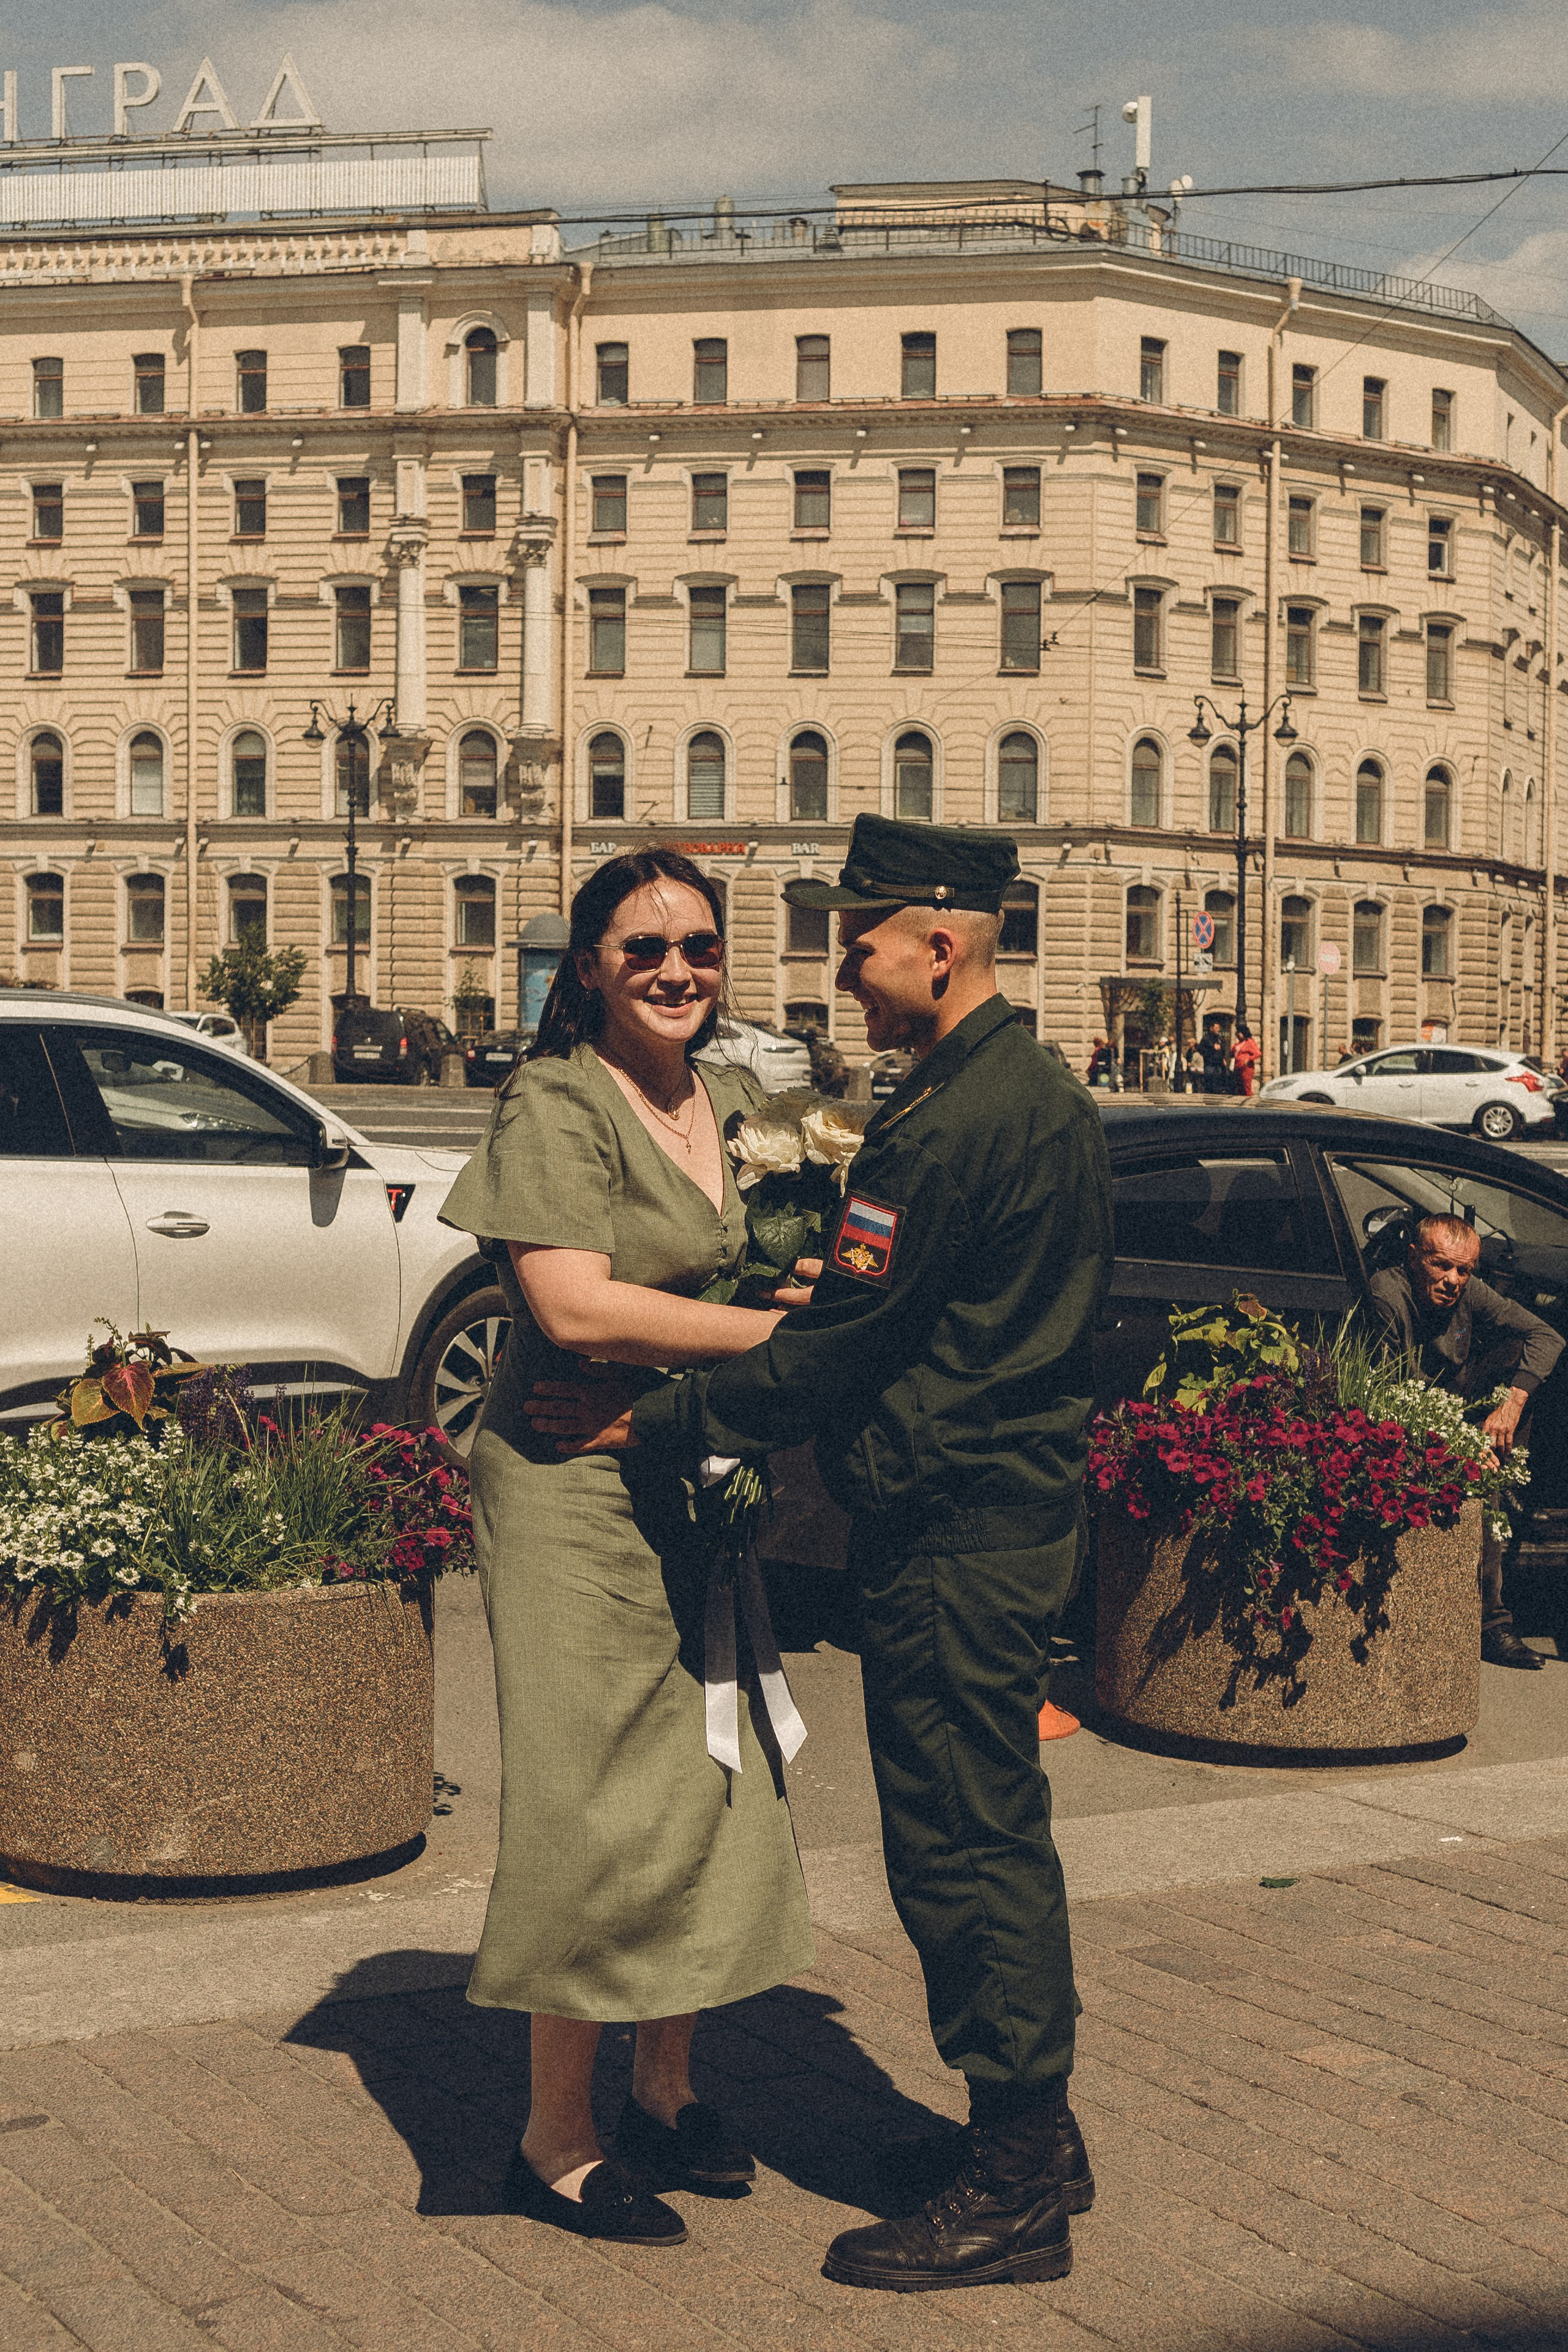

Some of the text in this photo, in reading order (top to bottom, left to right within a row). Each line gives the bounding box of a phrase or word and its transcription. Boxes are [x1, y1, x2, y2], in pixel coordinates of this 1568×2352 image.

[590, 842, 617, 853] БАР
[663, 842, 745, 854] ВОВАРНЯ
[793, 842, 820, 854] BAR
